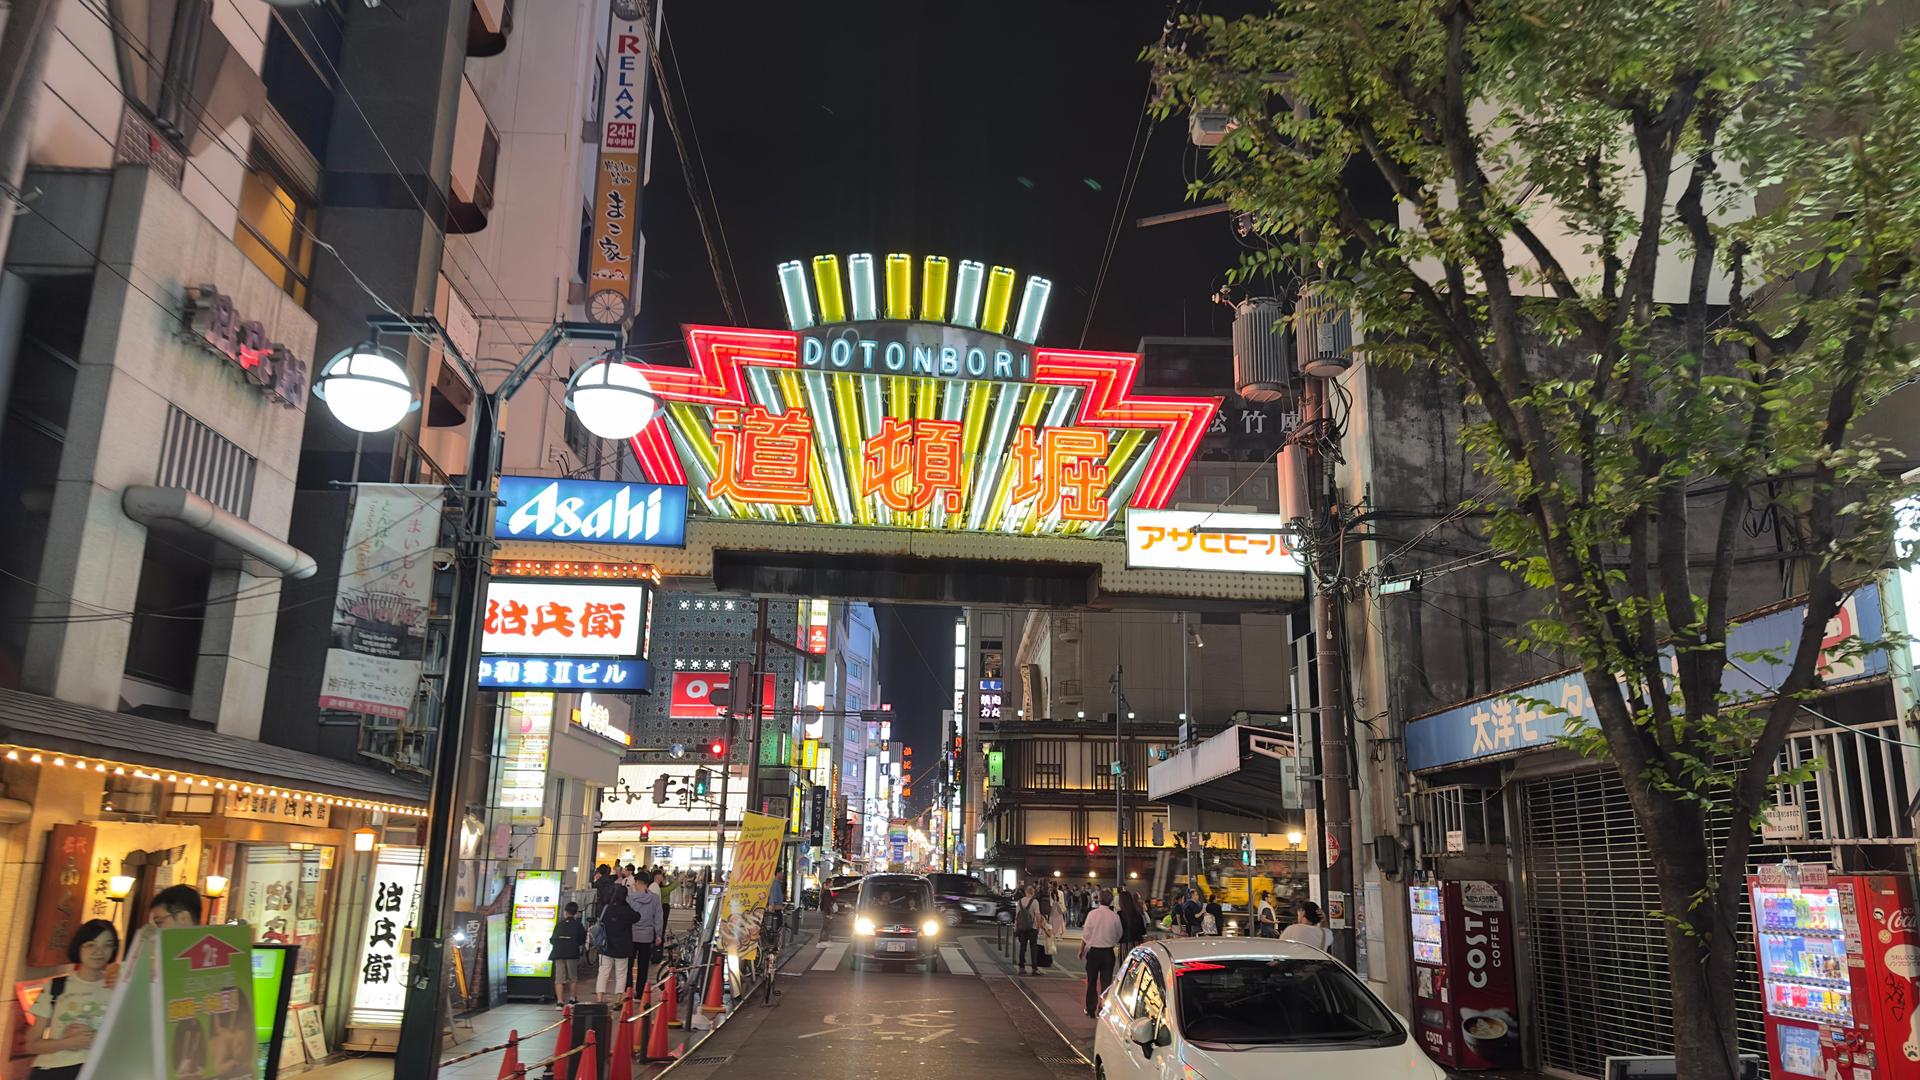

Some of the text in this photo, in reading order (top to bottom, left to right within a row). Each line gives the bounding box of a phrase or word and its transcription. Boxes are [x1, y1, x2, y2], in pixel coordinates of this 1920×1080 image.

[608, 125, 635, 138] 24H
[803, 336, 1030, 378] DOTONBORI
[1207, 409, 1301, 434] 松竹座
[707, 406, 1108, 522] 道頓堀
[509, 481, 663, 541] Asahi
[484, 599, 626, 639] 治兵衛
[981, 694, 1001, 705] 焼肉
[738, 838, 780, 862] TAKO
[736, 860, 775, 883] YAKI
[363, 882, 403, 985] 治兵衛
[1887, 909, 1917, 933] Coca
[1489, 917, 1501, 968] COFFEE
[1425, 1030, 1443, 1046] COSTA
